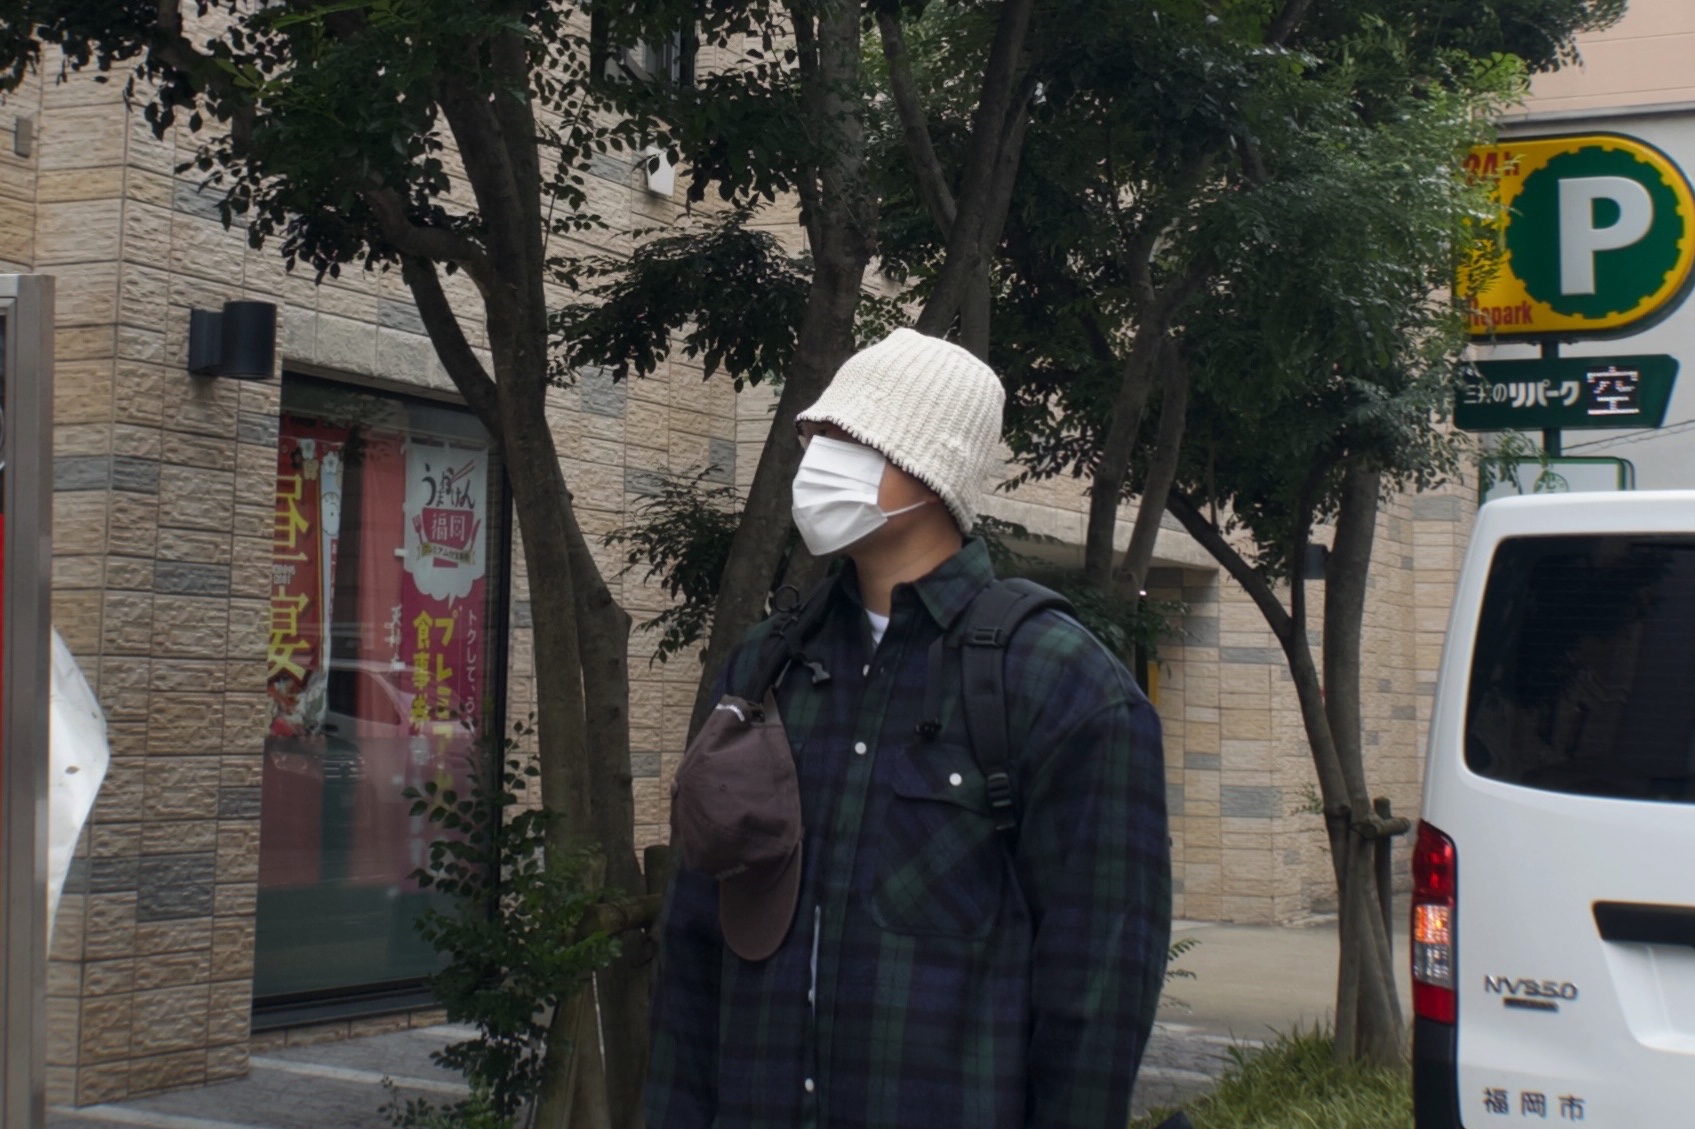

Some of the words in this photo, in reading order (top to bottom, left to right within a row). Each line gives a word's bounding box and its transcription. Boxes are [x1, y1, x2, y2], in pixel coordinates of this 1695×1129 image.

[1558, 176, 1653, 295] P
[1586, 365, 1640, 416] 空
[431, 512, 466, 542] 福岡
[1483, 973, 1579, 1001] NV350
[1482, 1087, 1587, 1122] 福岡市
